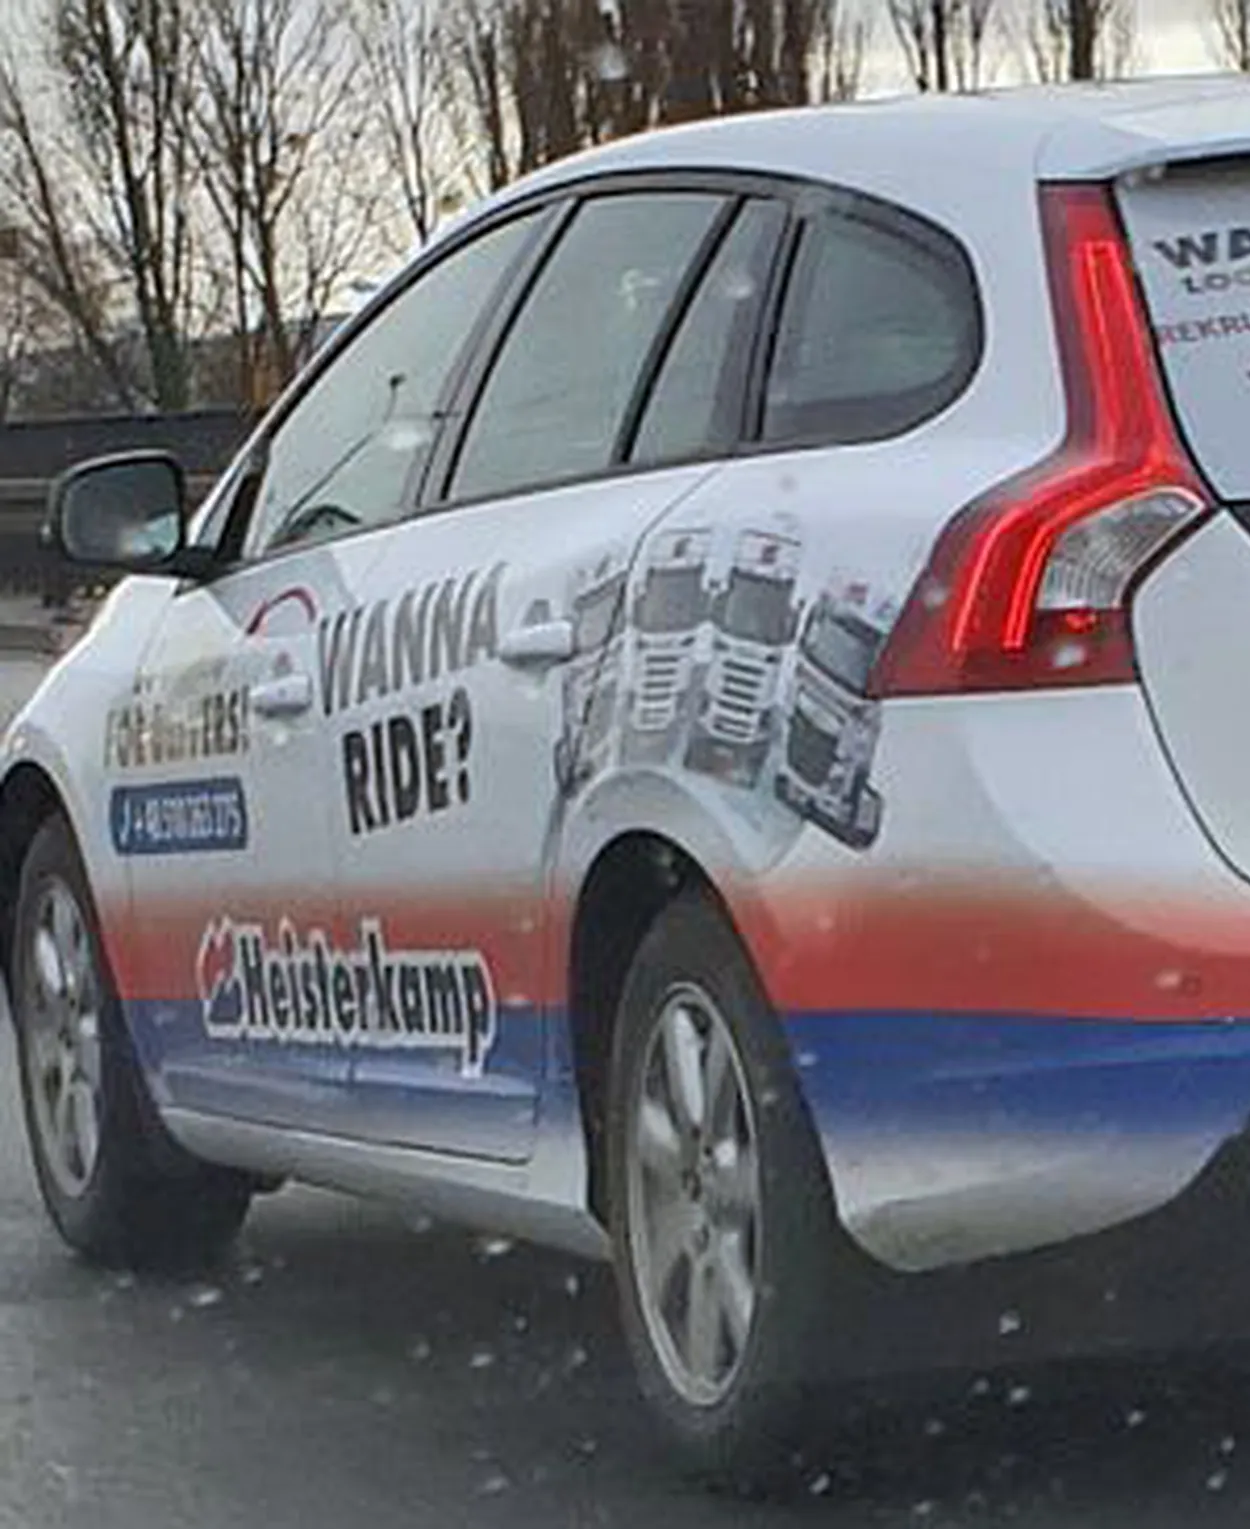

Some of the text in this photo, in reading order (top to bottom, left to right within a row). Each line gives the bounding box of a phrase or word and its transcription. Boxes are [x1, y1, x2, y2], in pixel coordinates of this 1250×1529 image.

[319, 561, 508, 716] WANNA
[343, 687, 472, 834] RIDE?
[237, 930, 493, 1066] Heisterkamp
